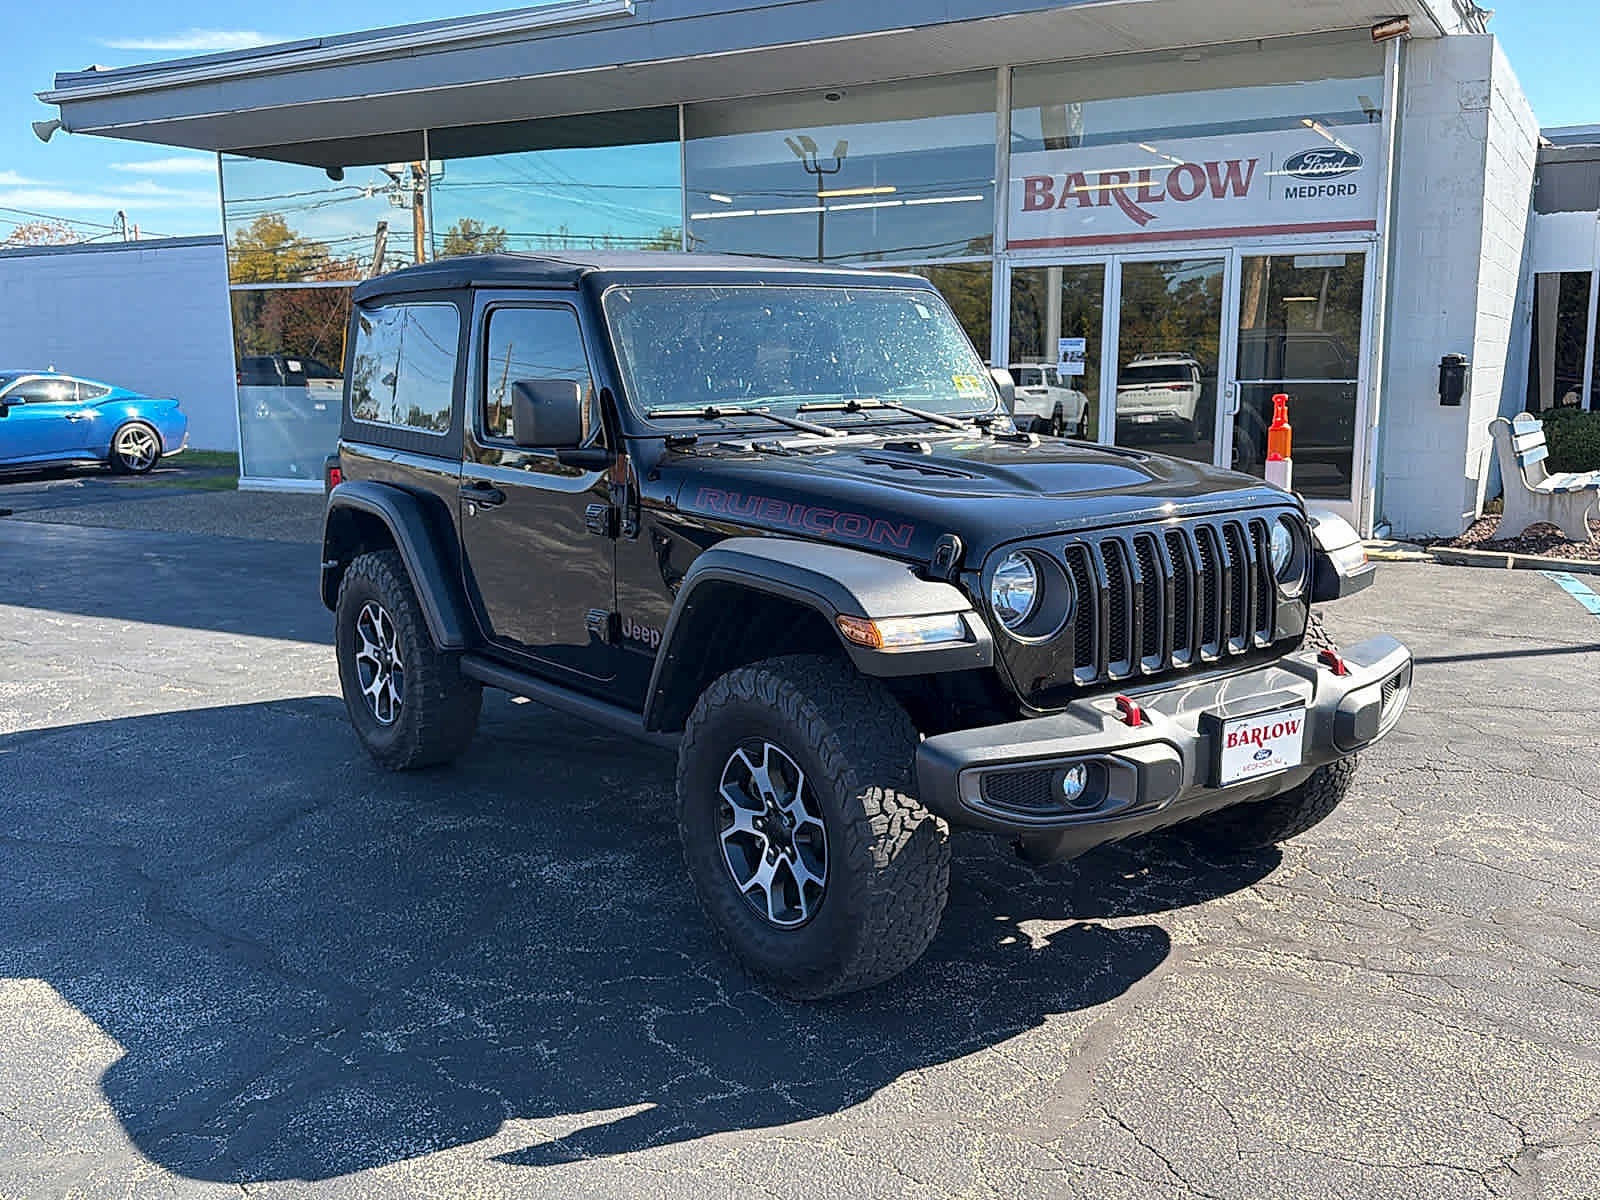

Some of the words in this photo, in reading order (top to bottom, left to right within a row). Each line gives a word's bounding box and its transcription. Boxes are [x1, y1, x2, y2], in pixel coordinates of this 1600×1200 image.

[1021, 158, 1260, 227] BARLOW
[1285, 183, 1357, 199] MEDFORD
[696, 487, 914, 548] RUBICON
[622, 617, 660, 648] Jeep
[1226, 719, 1302, 748] BARLOW
